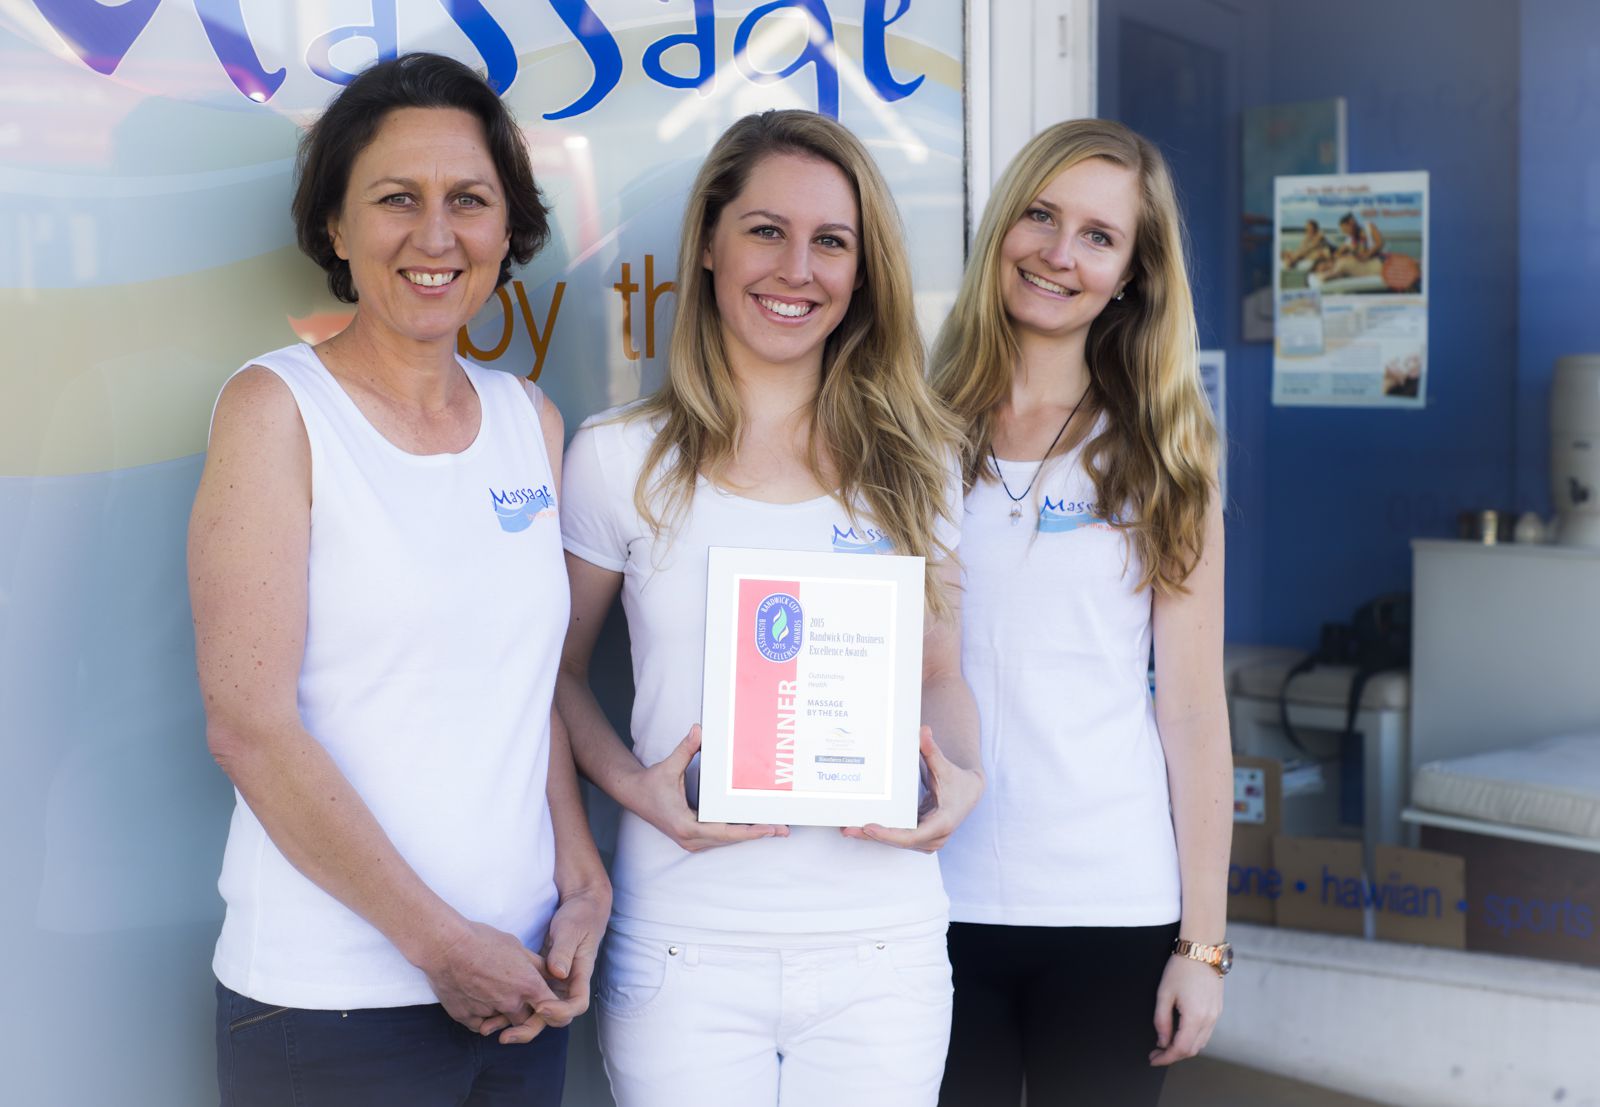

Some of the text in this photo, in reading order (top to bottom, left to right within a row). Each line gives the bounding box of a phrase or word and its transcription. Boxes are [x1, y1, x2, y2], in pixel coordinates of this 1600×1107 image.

[614, 254, 678, 361] th
[489, 485, 551, 511] Massage
[810, 617, 825, 628] 2015
[758, 619, 767, 648] BUSINESS
[809, 631, 885, 644] Randwick City Business
[809, 645, 868, 657] Excellence Awards
[807, 699, 844, 708] MASSAGE
[806, 709, 849, 718] BY THE SEA
[775, 680, 798, 785] WINNER
[1483, 892, 1595, 940] sports
